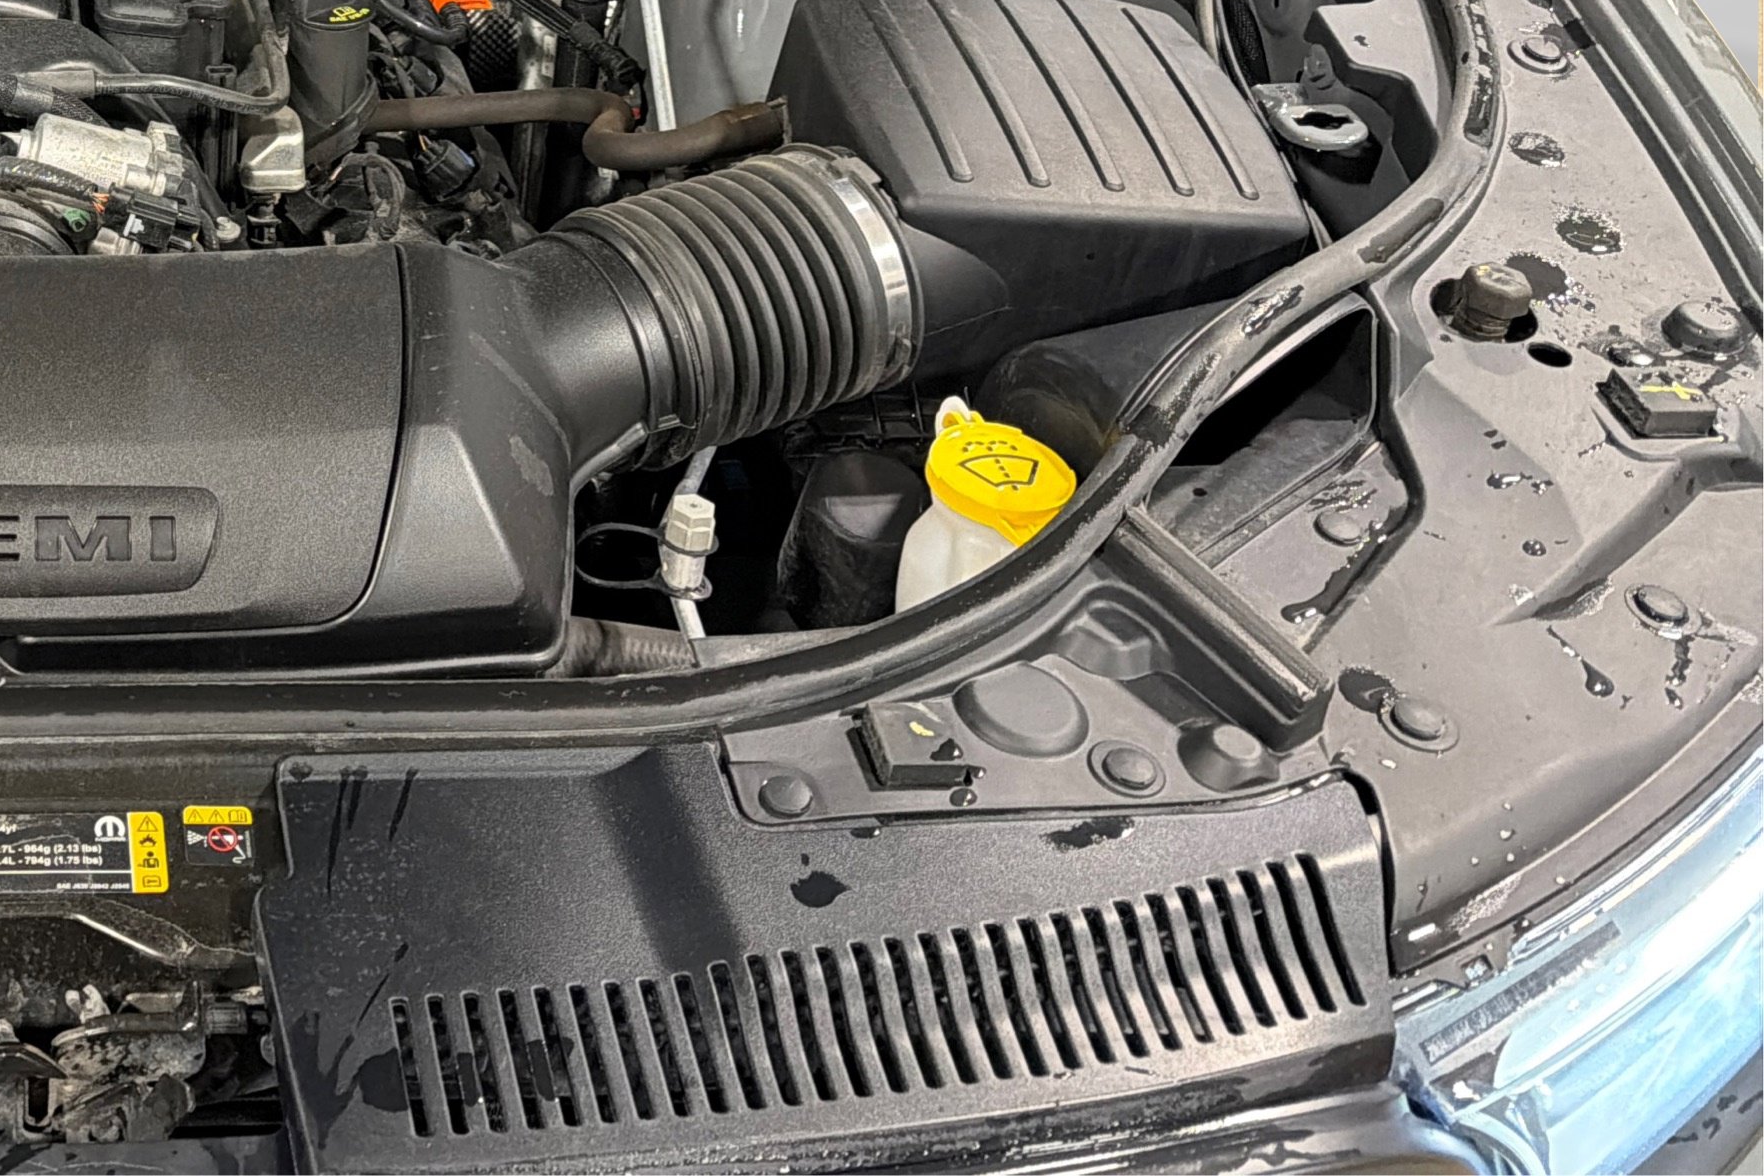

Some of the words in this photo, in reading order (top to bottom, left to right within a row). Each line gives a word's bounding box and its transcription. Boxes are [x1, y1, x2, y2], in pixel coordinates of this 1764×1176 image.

[54, 843, 79, 855] (2.13
[81, 843, 102, 855] lbs)
[24, 855, 51, 867] 794g
[54, 855, 80, 867] (1.75
[82, 855, 103, 867] lbs)
